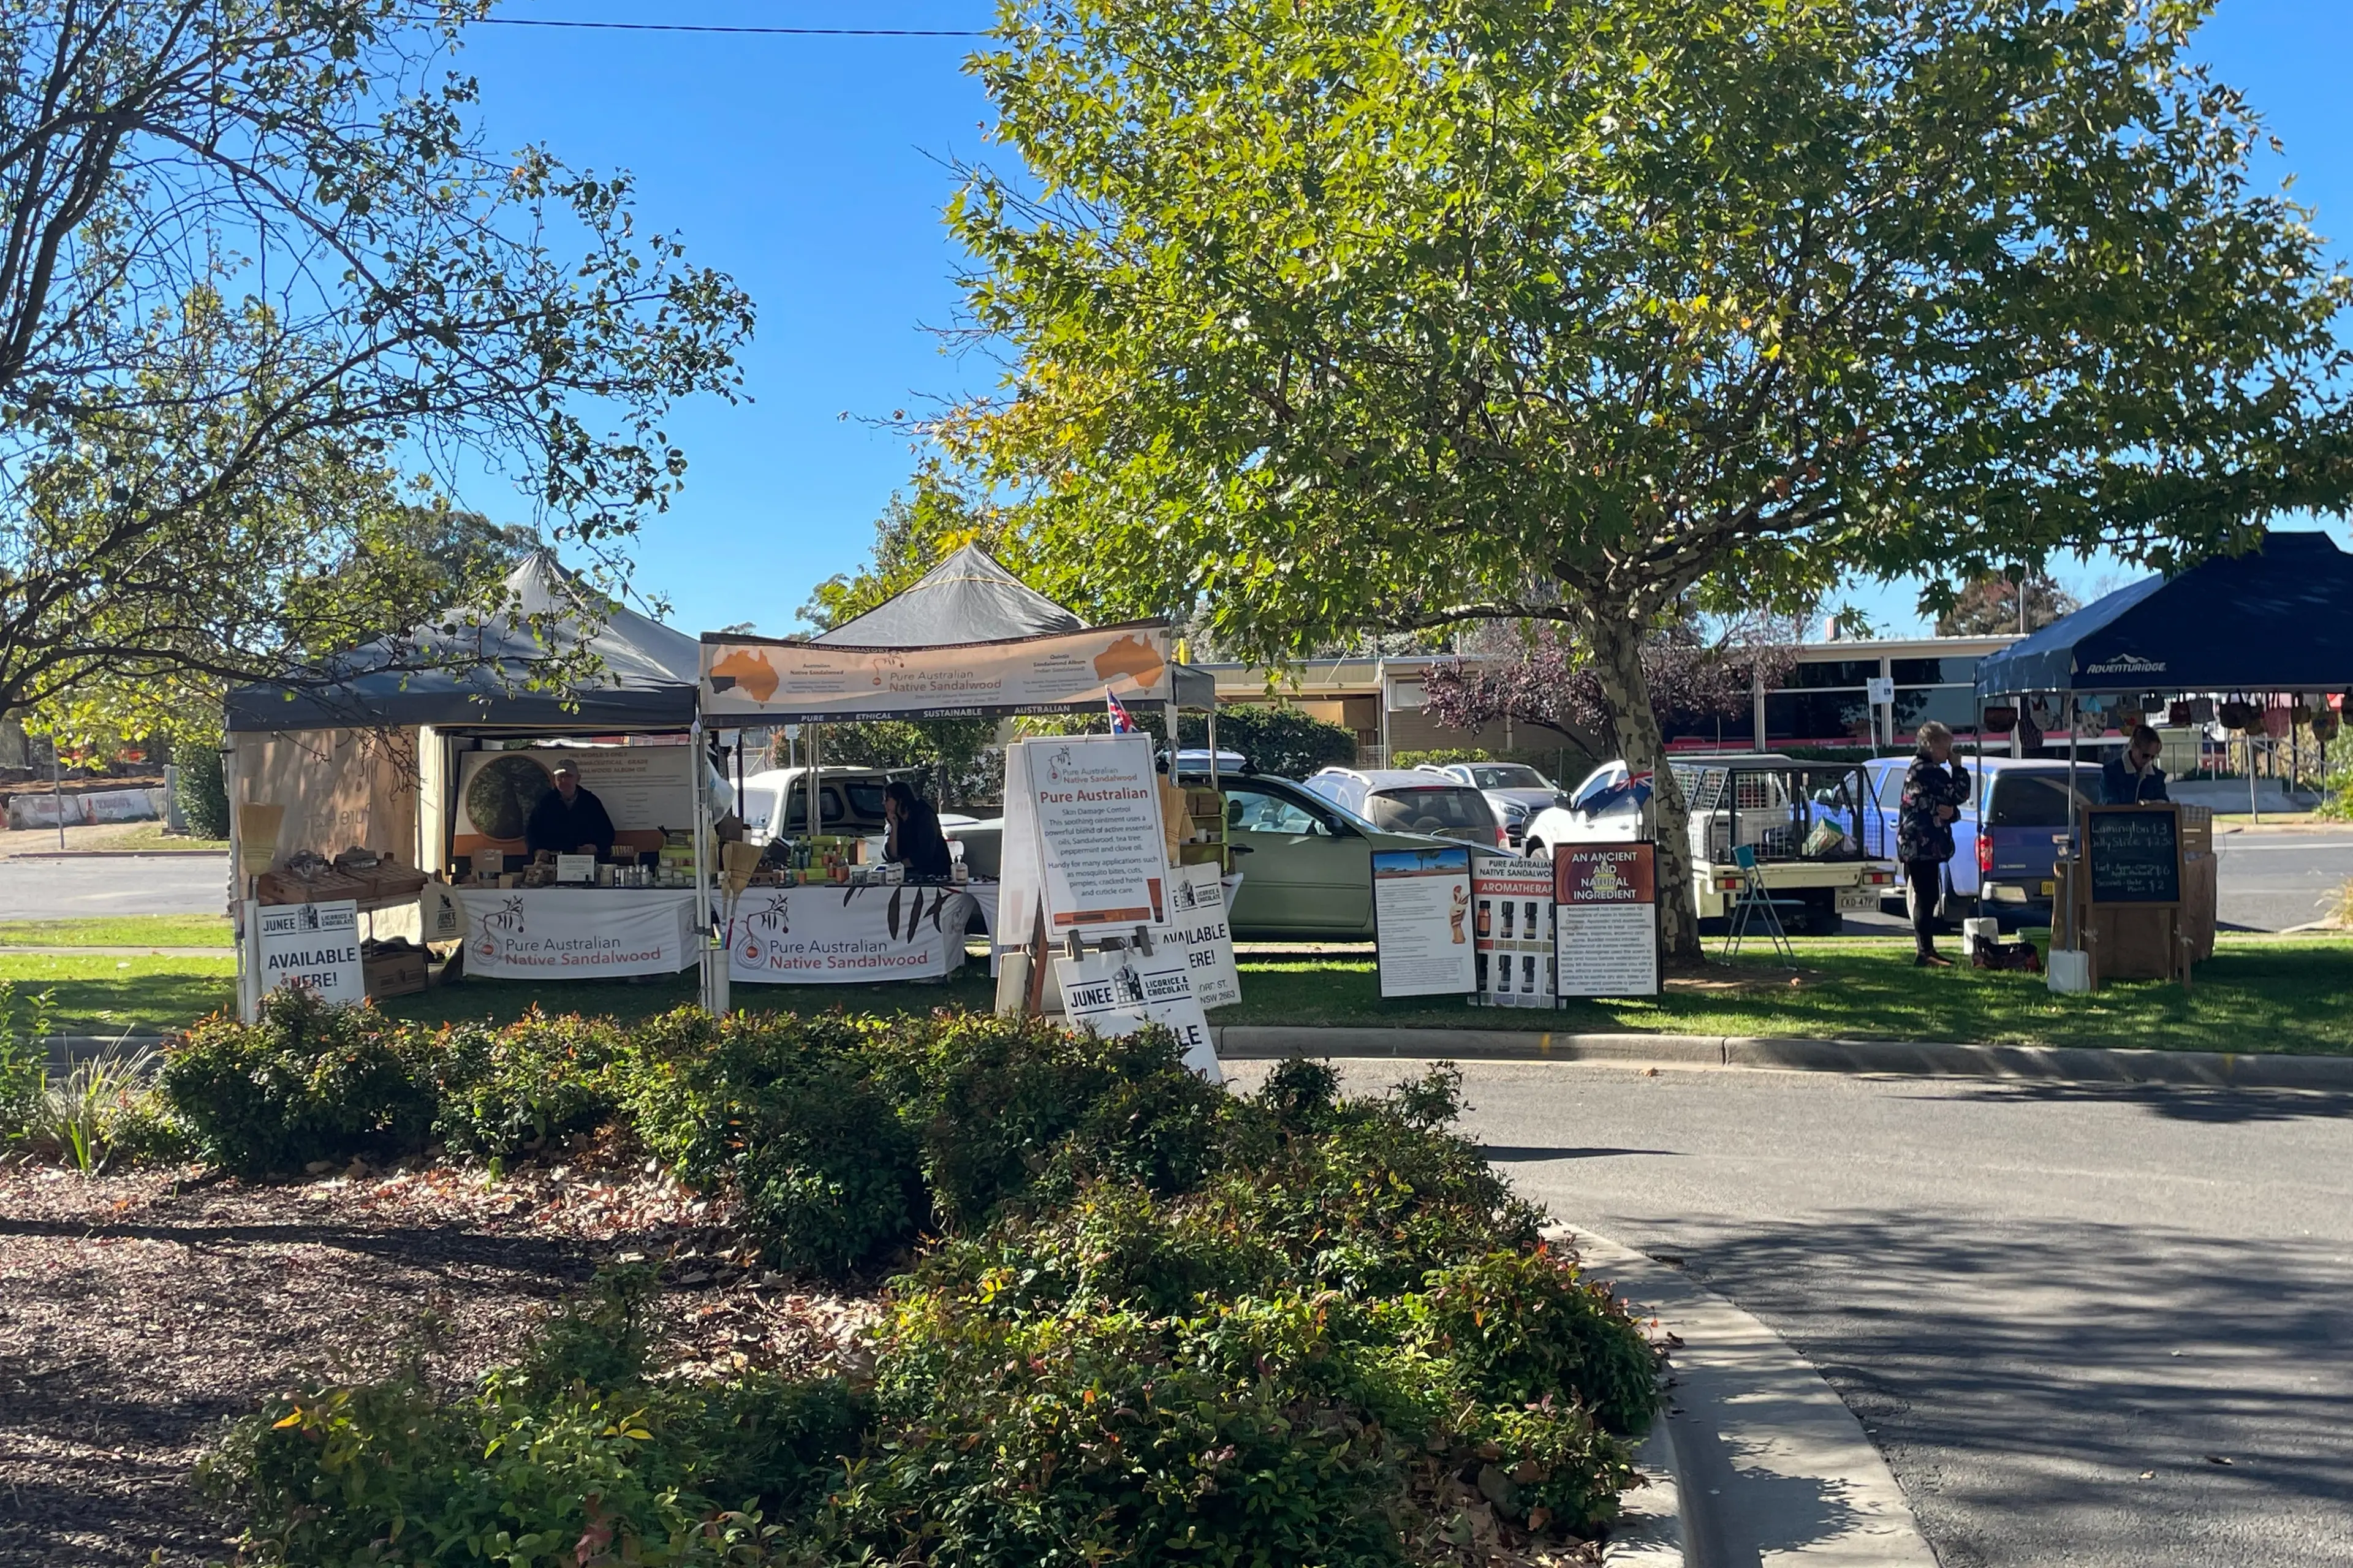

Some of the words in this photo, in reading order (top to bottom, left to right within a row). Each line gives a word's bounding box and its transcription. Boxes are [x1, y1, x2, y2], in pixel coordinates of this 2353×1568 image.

[2086, 662, 2166, 675] ADVENTURIDGE
[890, 673, 914, 681] Pure
[917, 669, 973, 680] Australian
[889, 682, 926, 693] Native
[930, 679, 1002, 692] Sandalwood
[855, 713, 892, 721] ETHICAL
[923, 708, 982, 718] SUSTAINABLE
[1014, 705, 1070, 715] AUSTRALIAN
[1080, 767, 1118, 775] Australian
[1090, 774, 1138, 783] Sandalwood
[1040, 791, 1074, 804] Pure
[1077, 787, 1148, 802] Australian
[1077, 808, 1105, 816] Damage
[1064, 817, 1094, 827] soothing
[1044, 828, 1074, 837] powerful
[2091, 820, 2149, 839] Lamington
[1060, 846, 1100, 857] peppermint
[1572, 853, 1588, 863] AN
[1591, 851, 1637, 862] ANCIENT
[1048, 860, 1070, 869] Handy
[1082, 859, 1101, 868] many
[1101, 857, 1142, 867] applications
[1509, 860, 1553, 869] AUSTRALIAN
[1075, 869, 1108, 878] mosquito
[1593, 865, 1617, 874] AND
[1099, 877, 1124, 886] cracked
[1580, 876, 1629, 888] NATURAL
[1095, 887, 1118, 896] cuticle
[1195, 888, 1214, 897] LICORICE
[1574, 889, 1637, 900] INGREDIENT
[1197, 894, 1221, 903] CHOCOLATE
[263, 918, 296, 932] JUNEE
[321, 918, 355, 927] CHOCOLATE
[1163, 923, 1227, 945] AVAILABLE
[506, 938, 539, 952] Pure
[544, 936, 621, 951] Australian
[770, 939, 805, 954] Pure
[808, 938, 887, 954] Australian
[268, 947, 357, 970] AVAILABLE
[506, 953, 556, 966] Native
[561, 947, 661, 966] Sandalwood
[770, 955, 822, 969] Native
[827, 950, 928, 969] Sandalwood
[1188, 949, 1216, 969] ERE!
[1145, 977, 1181, 989] LICORICE
[1147, 985, 1191, 997] CHOCOLATE
[1071, 987, 1114, 1008] JUNEE
[1200, 993, 1218, 1005] NSW
